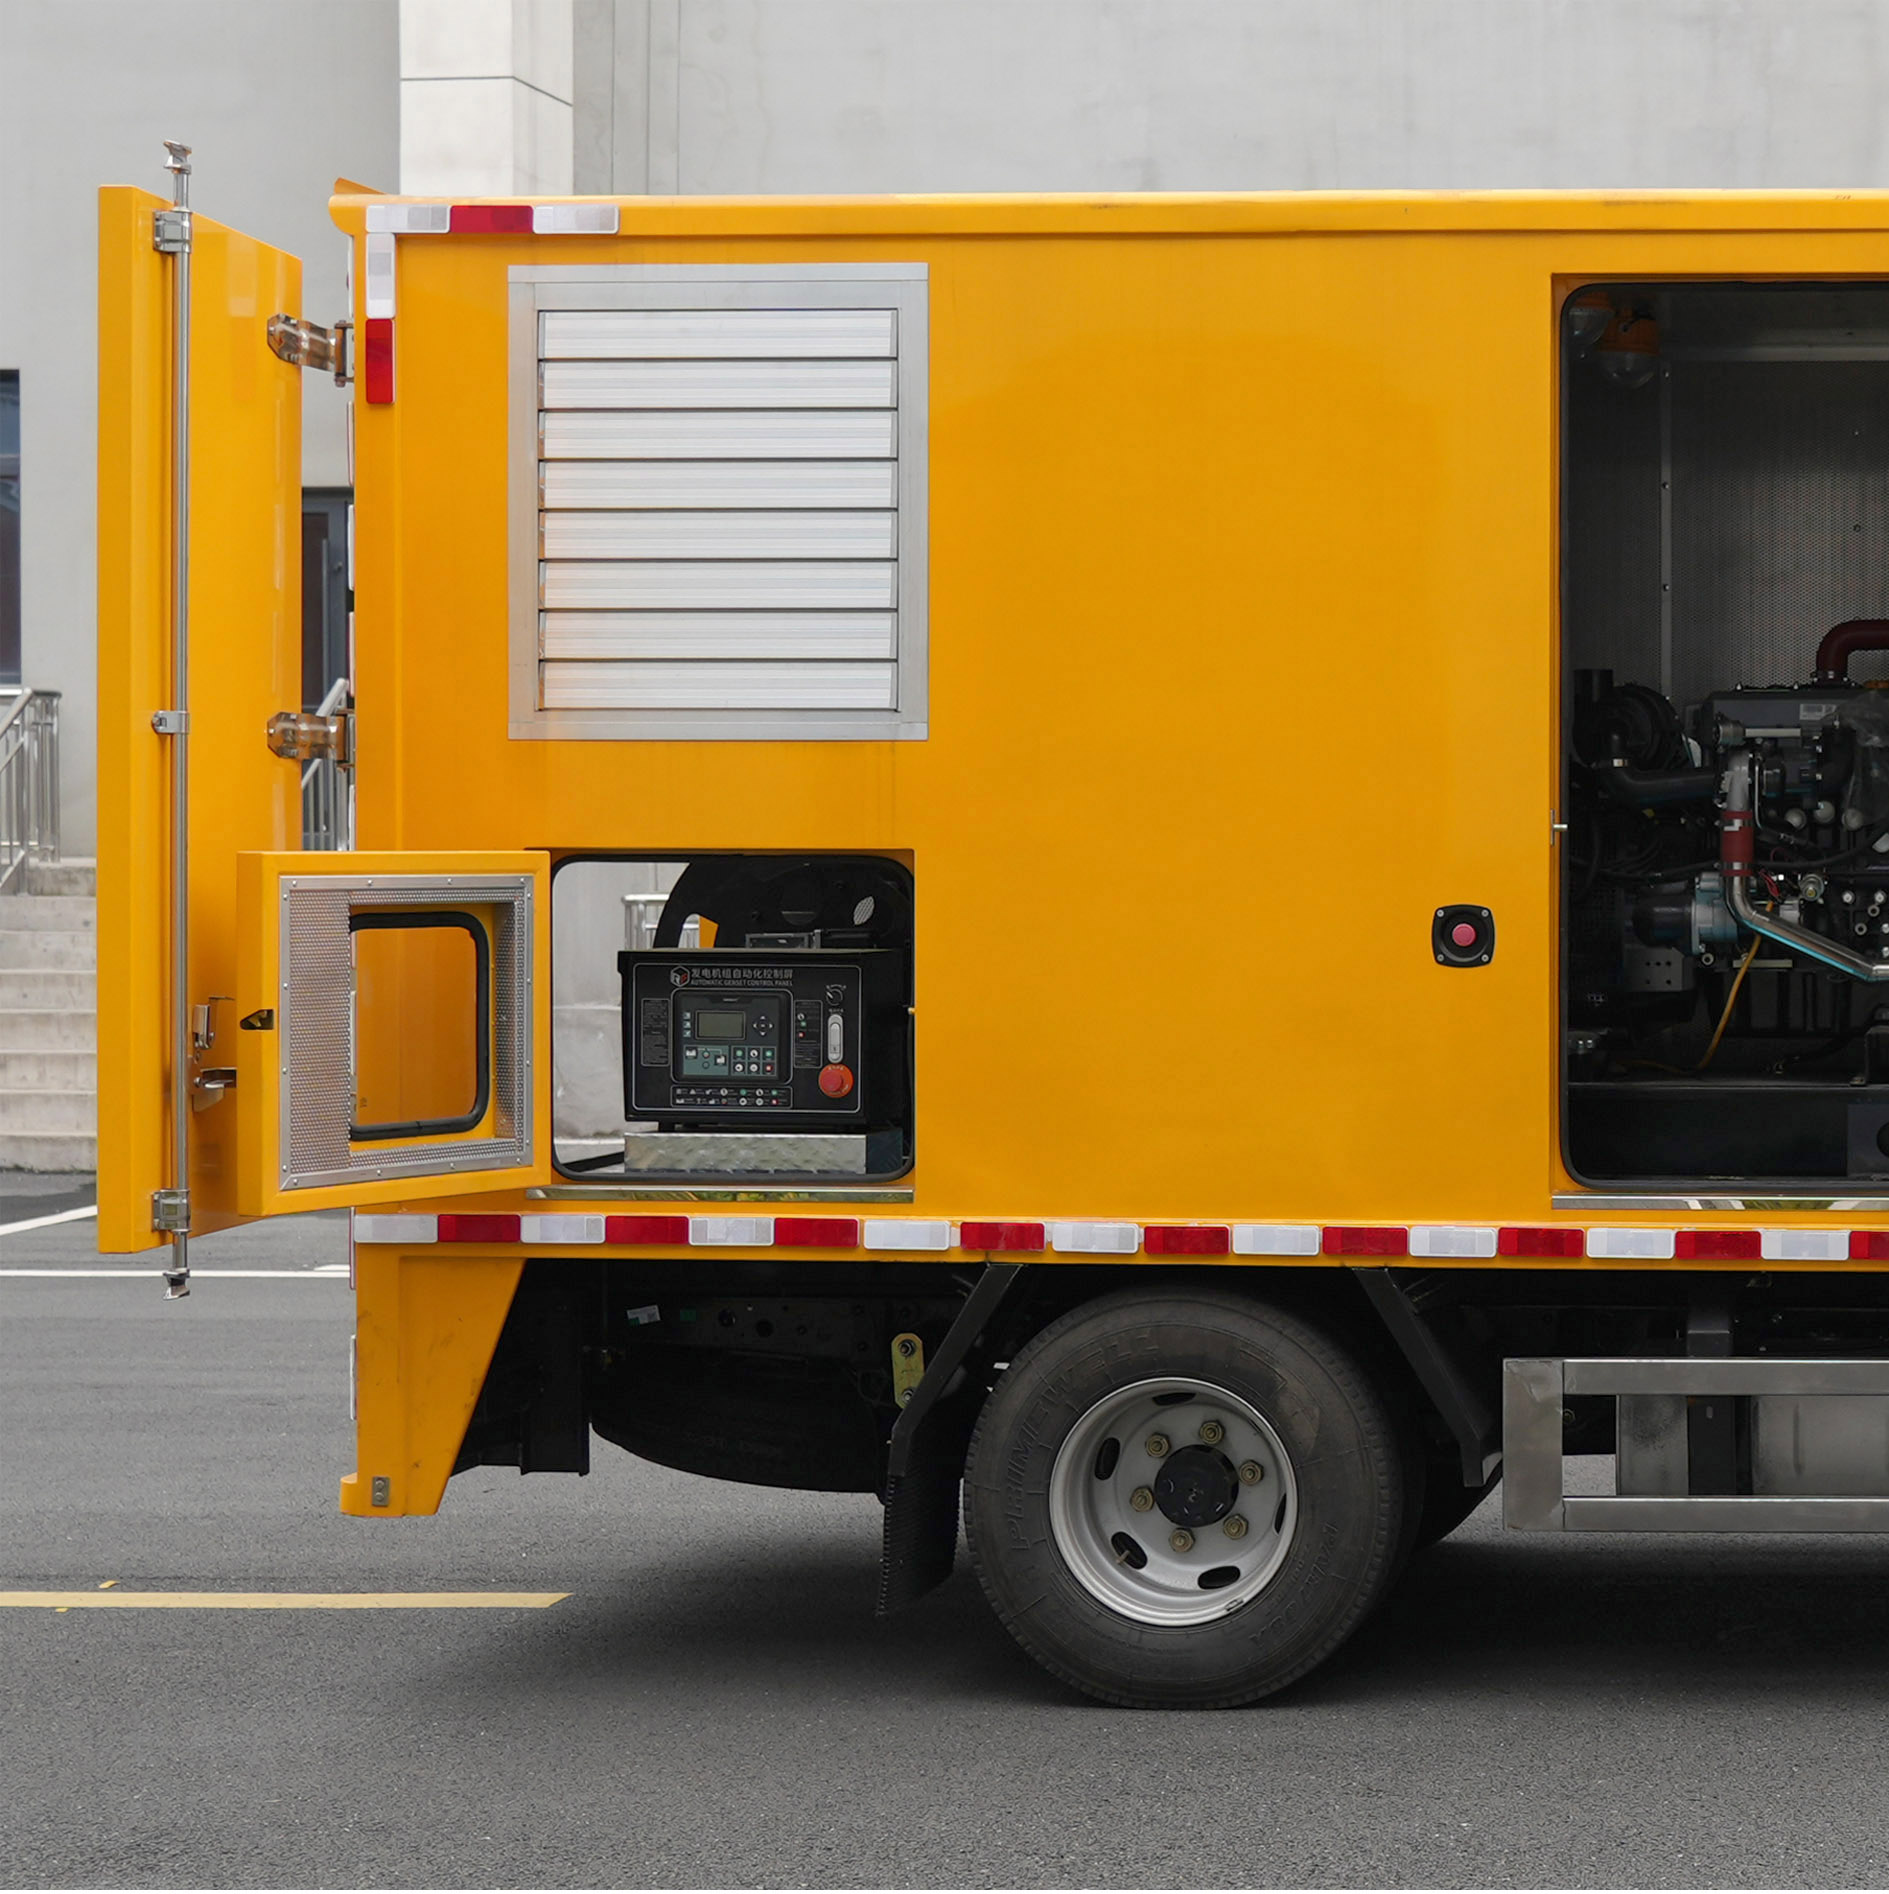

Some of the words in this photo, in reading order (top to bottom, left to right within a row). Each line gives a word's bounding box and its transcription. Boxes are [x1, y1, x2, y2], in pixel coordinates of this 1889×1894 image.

[691, 968, 793, 979] 发电机组自动化控制屏
[747, 979, 774, 987] CONTROL
